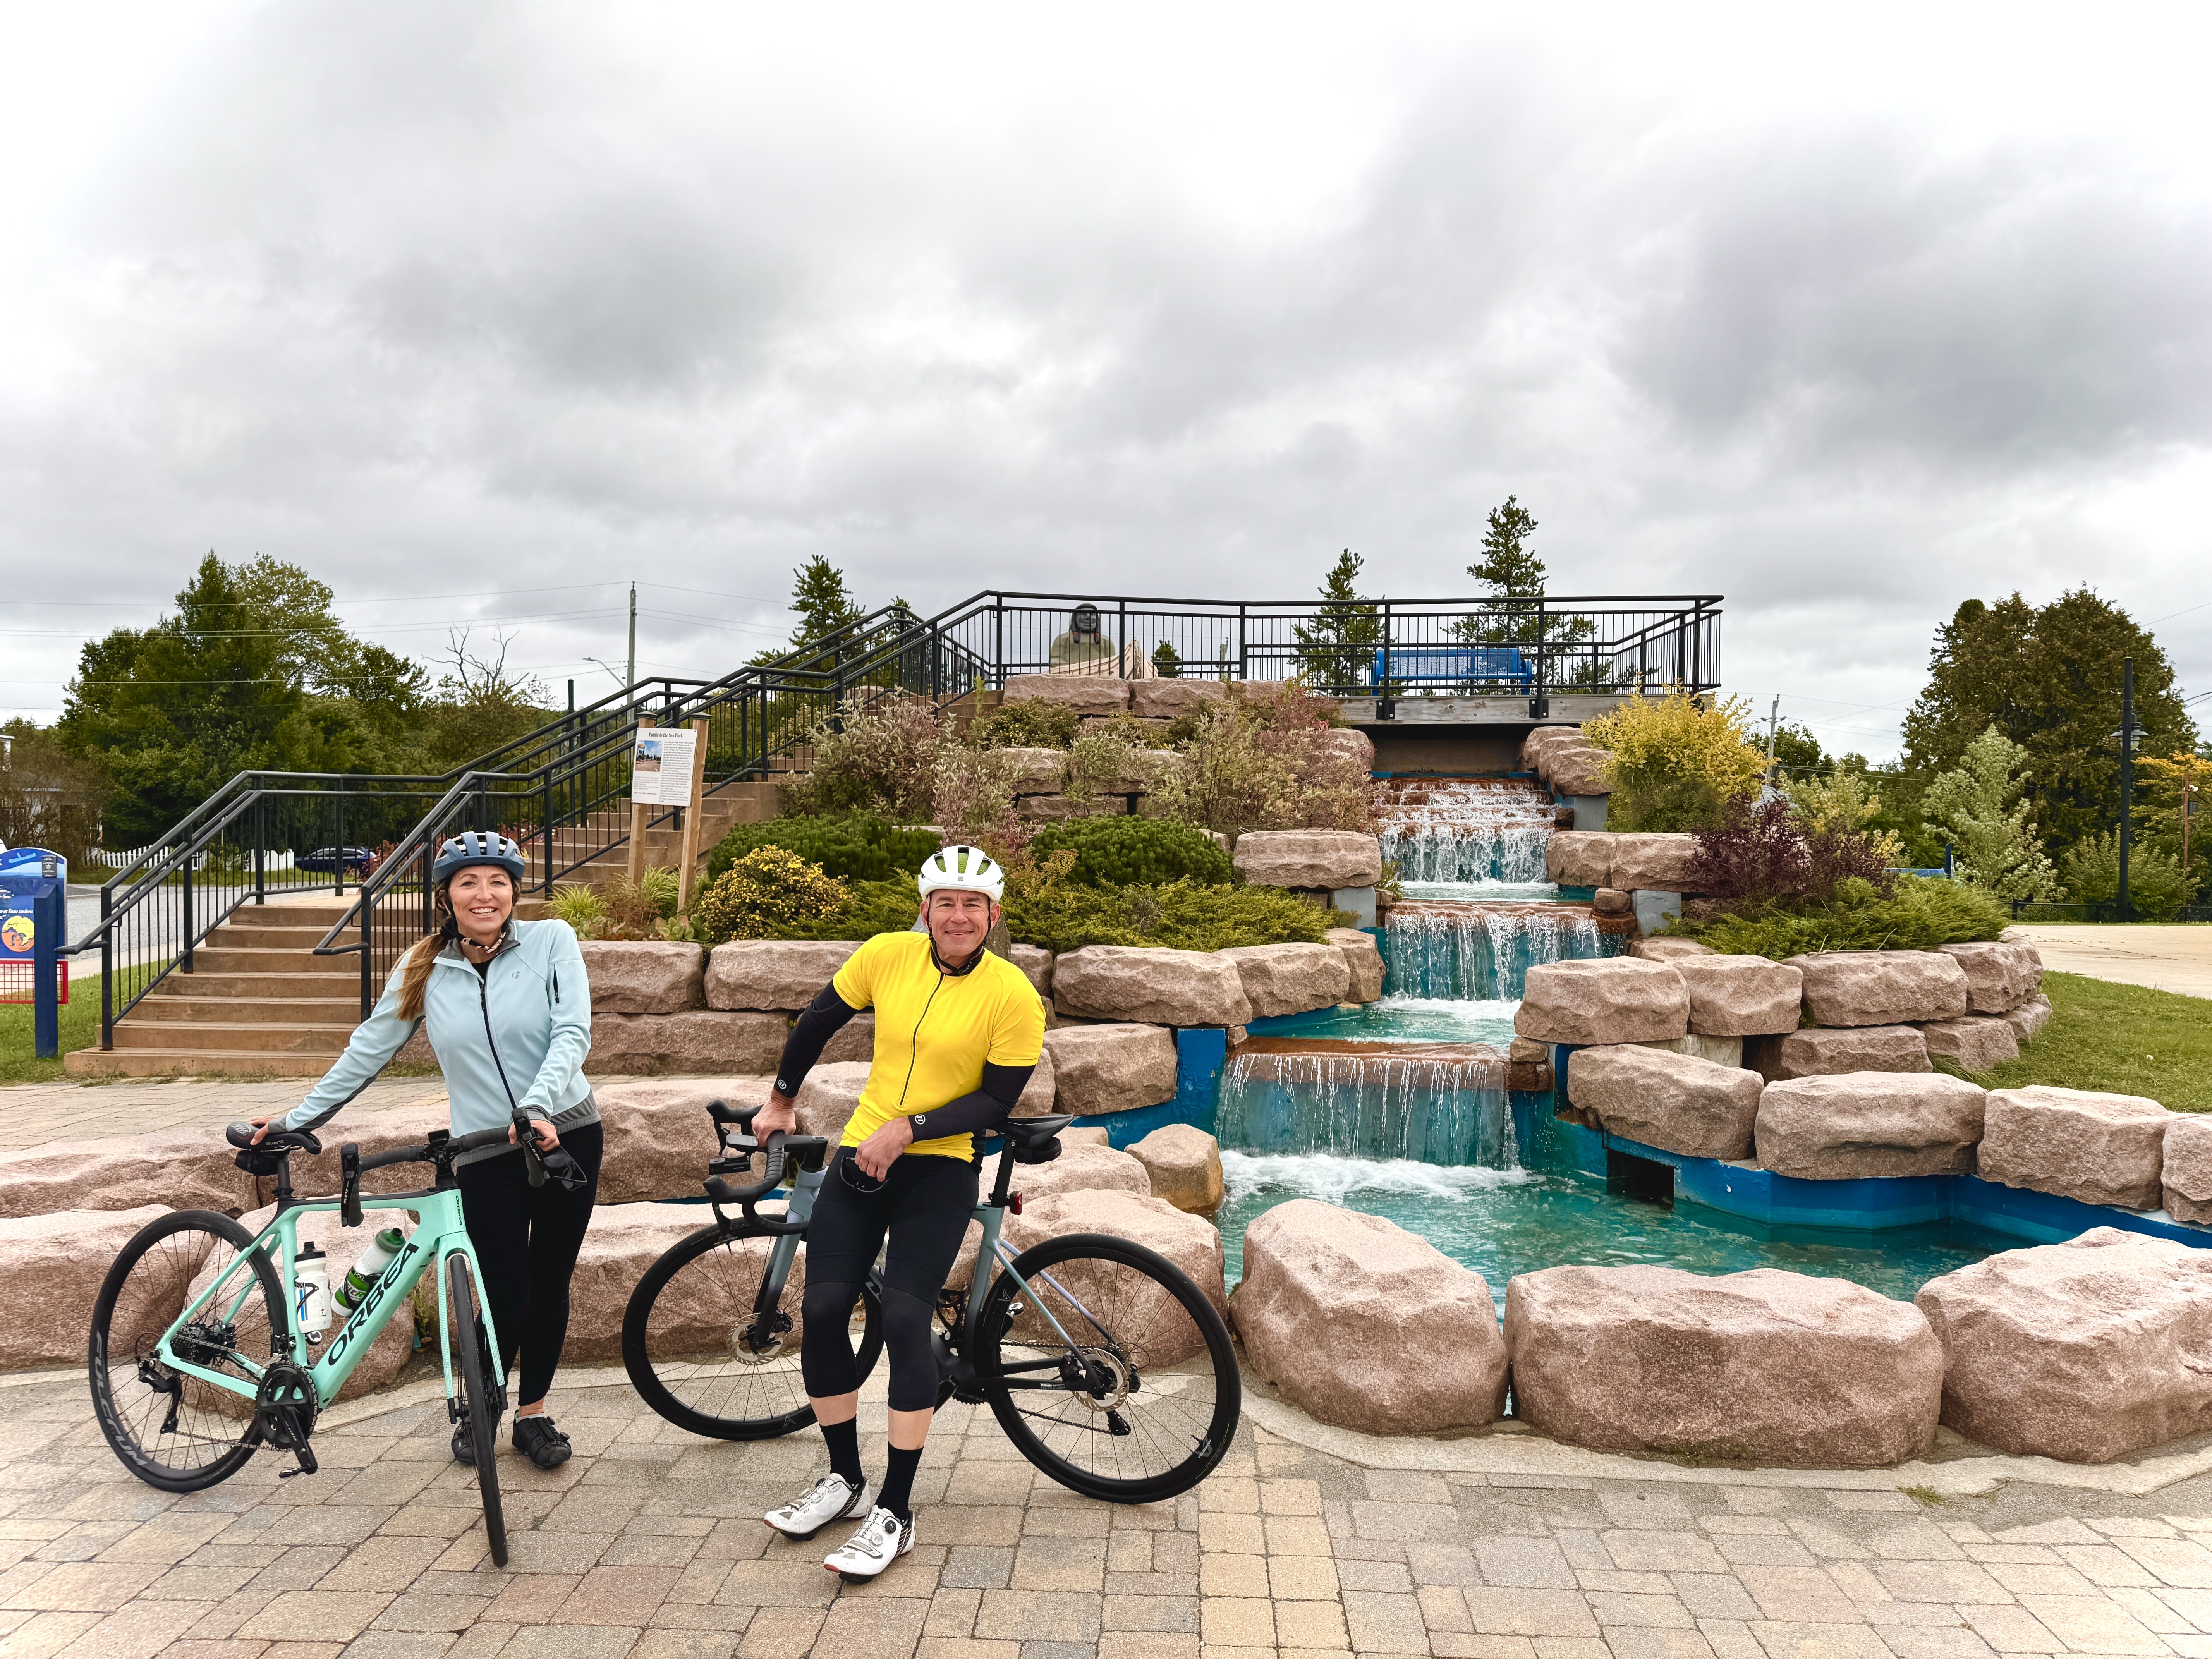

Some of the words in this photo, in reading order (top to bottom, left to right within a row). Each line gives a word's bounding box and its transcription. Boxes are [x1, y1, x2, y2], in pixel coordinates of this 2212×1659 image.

[328, 1242, 420, 1366] ORBEA
[354, 1271, 366, 1282] RXL
[95, 1330, 148, 1466] FULCRUM
